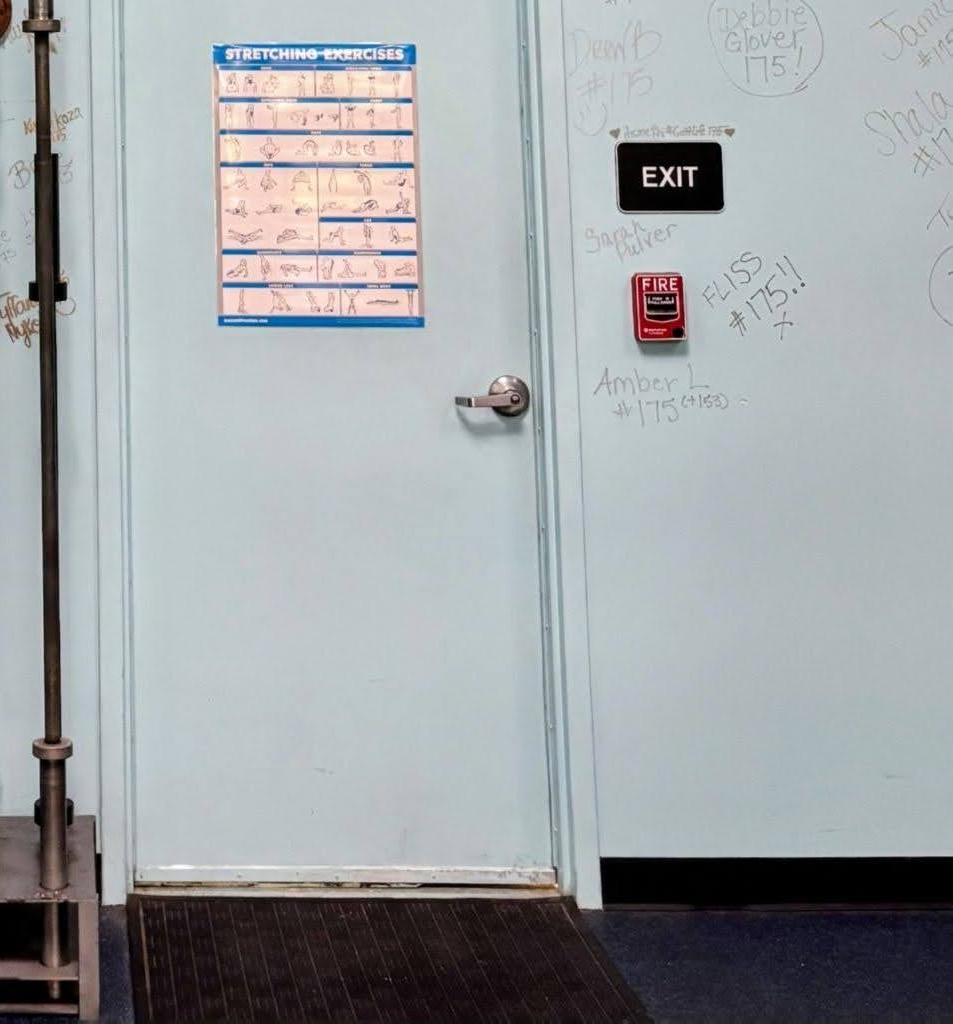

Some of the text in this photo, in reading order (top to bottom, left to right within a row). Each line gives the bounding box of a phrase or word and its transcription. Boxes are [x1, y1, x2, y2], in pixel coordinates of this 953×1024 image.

[225, 47, 404, 61] STRETCHING EXERCISES
[642, 166, 698, 188] EXIT
[642, 277, 679, 292] FIRE
[593, 367, 679, 397] Amber
